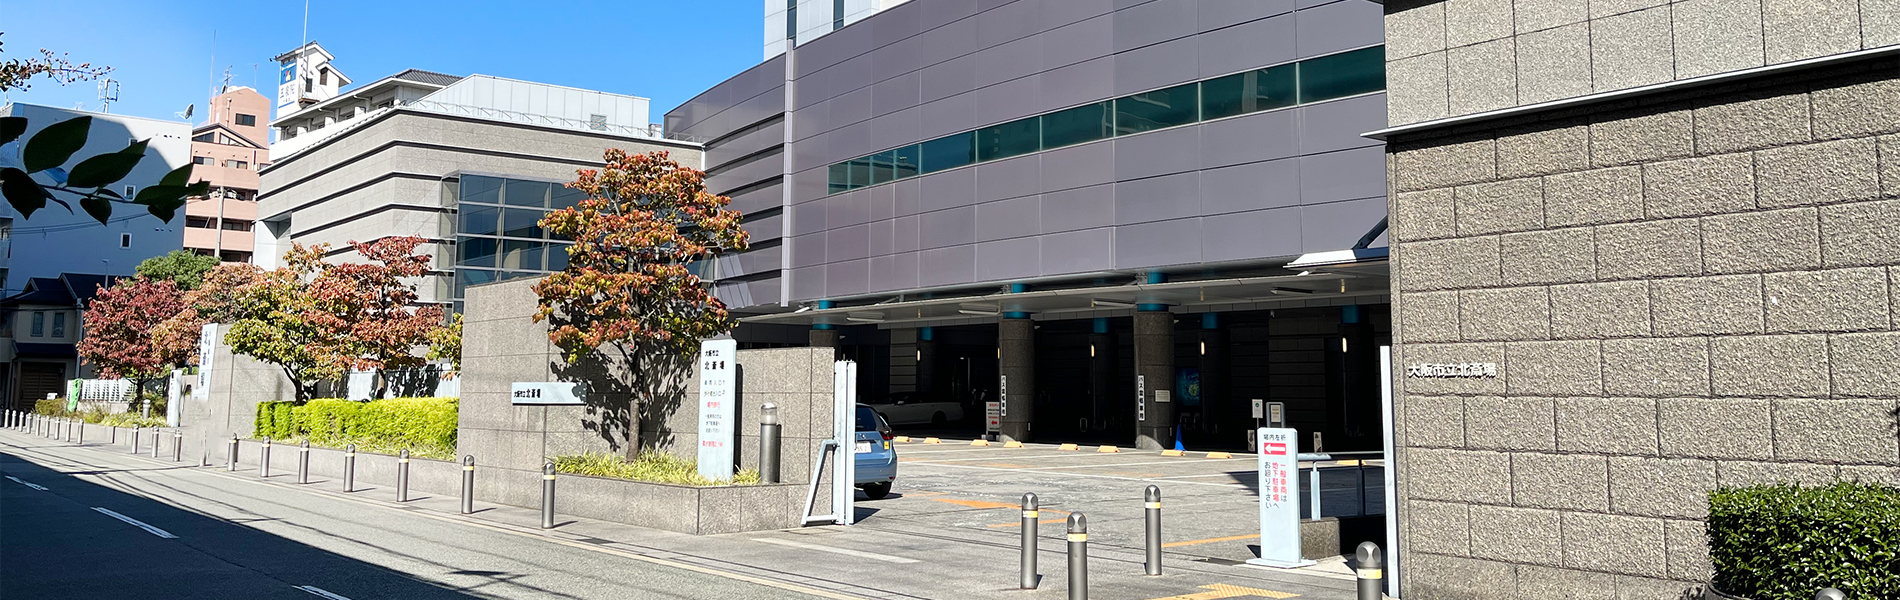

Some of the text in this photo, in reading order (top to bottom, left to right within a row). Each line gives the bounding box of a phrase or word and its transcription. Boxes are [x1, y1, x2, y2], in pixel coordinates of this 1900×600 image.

[1408, 363, 1497, 379] 大阪市立北斎場
